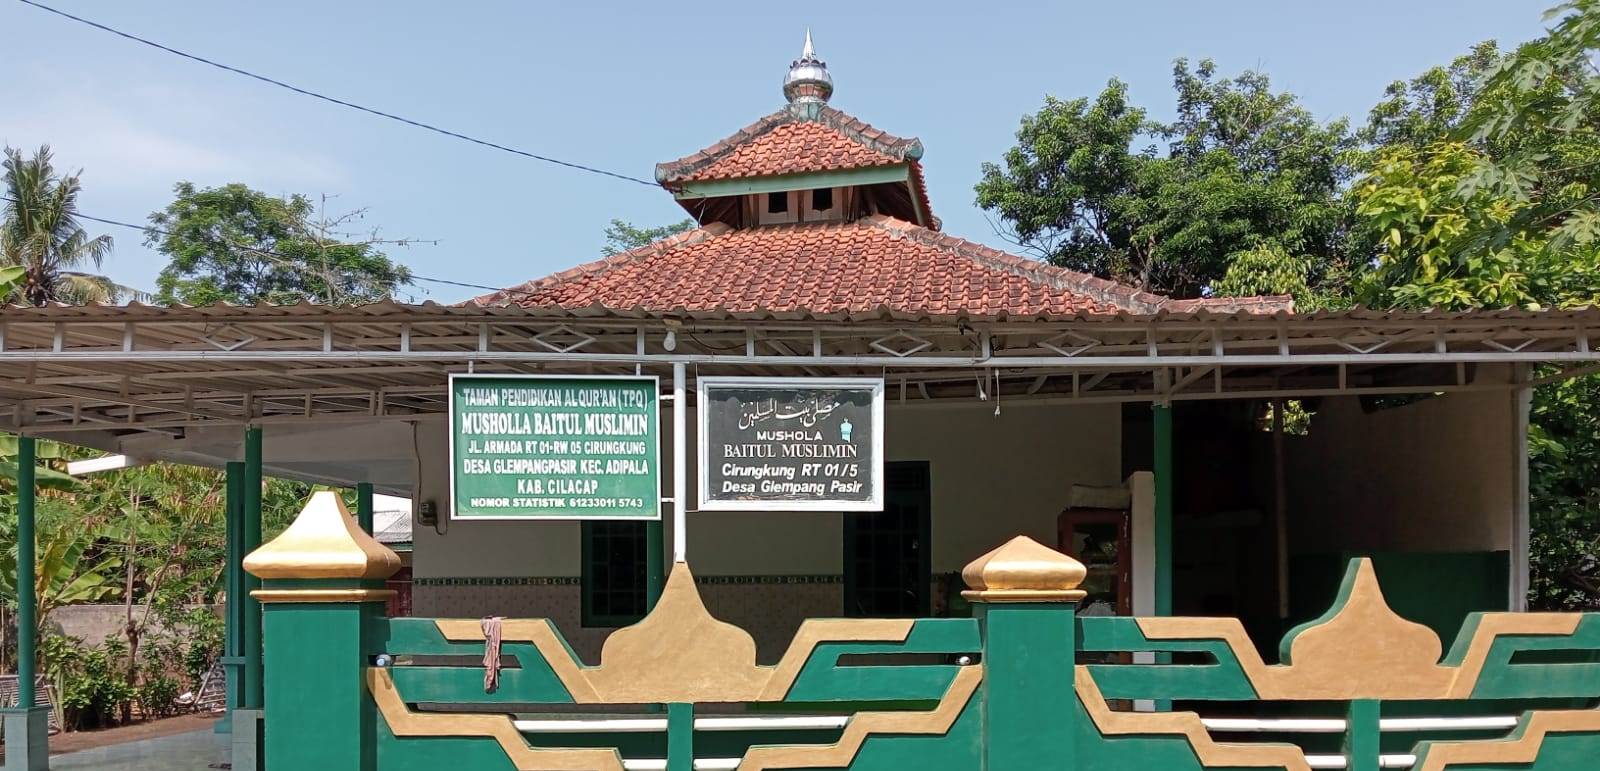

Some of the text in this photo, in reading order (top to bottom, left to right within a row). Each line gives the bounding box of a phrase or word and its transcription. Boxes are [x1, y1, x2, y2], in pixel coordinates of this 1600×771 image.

[464, 388, 499, 406] TAMAN
[502, 389, 561, 406] PENDIDIKAN
[618, 390, 648, 411] (TPQ)
[462, 412, 648, 435] MUSHOLLA BAITUL MUSLIMIN
[757, 431, 823, 441] MUSHOLA
[469, 440, 482, 453] JL.
[484, 441, 522, 454] ARMADA
[526, 441, 537, 454] RT
[571, 441, 581, 454] 05
[584, 442, 645, 454] CIRUNGKUNG
[724, 444, 857, 457] BAITUL MUSLIMIN
[464, 460, 648, 474] DESA GLEMPANGPASIR KEC. ADIPALA
[722, 463, 795, 479] Cirungkung
[802, 464, 821, 476] RT
[518, 480, 598, 494] KAB. CILACAP
[722, 480, 862, 495] Desa Glempang Pasir
[471, 498, 510, 507] NOMOR
[513, 498, 565, 507] STATISTIK
